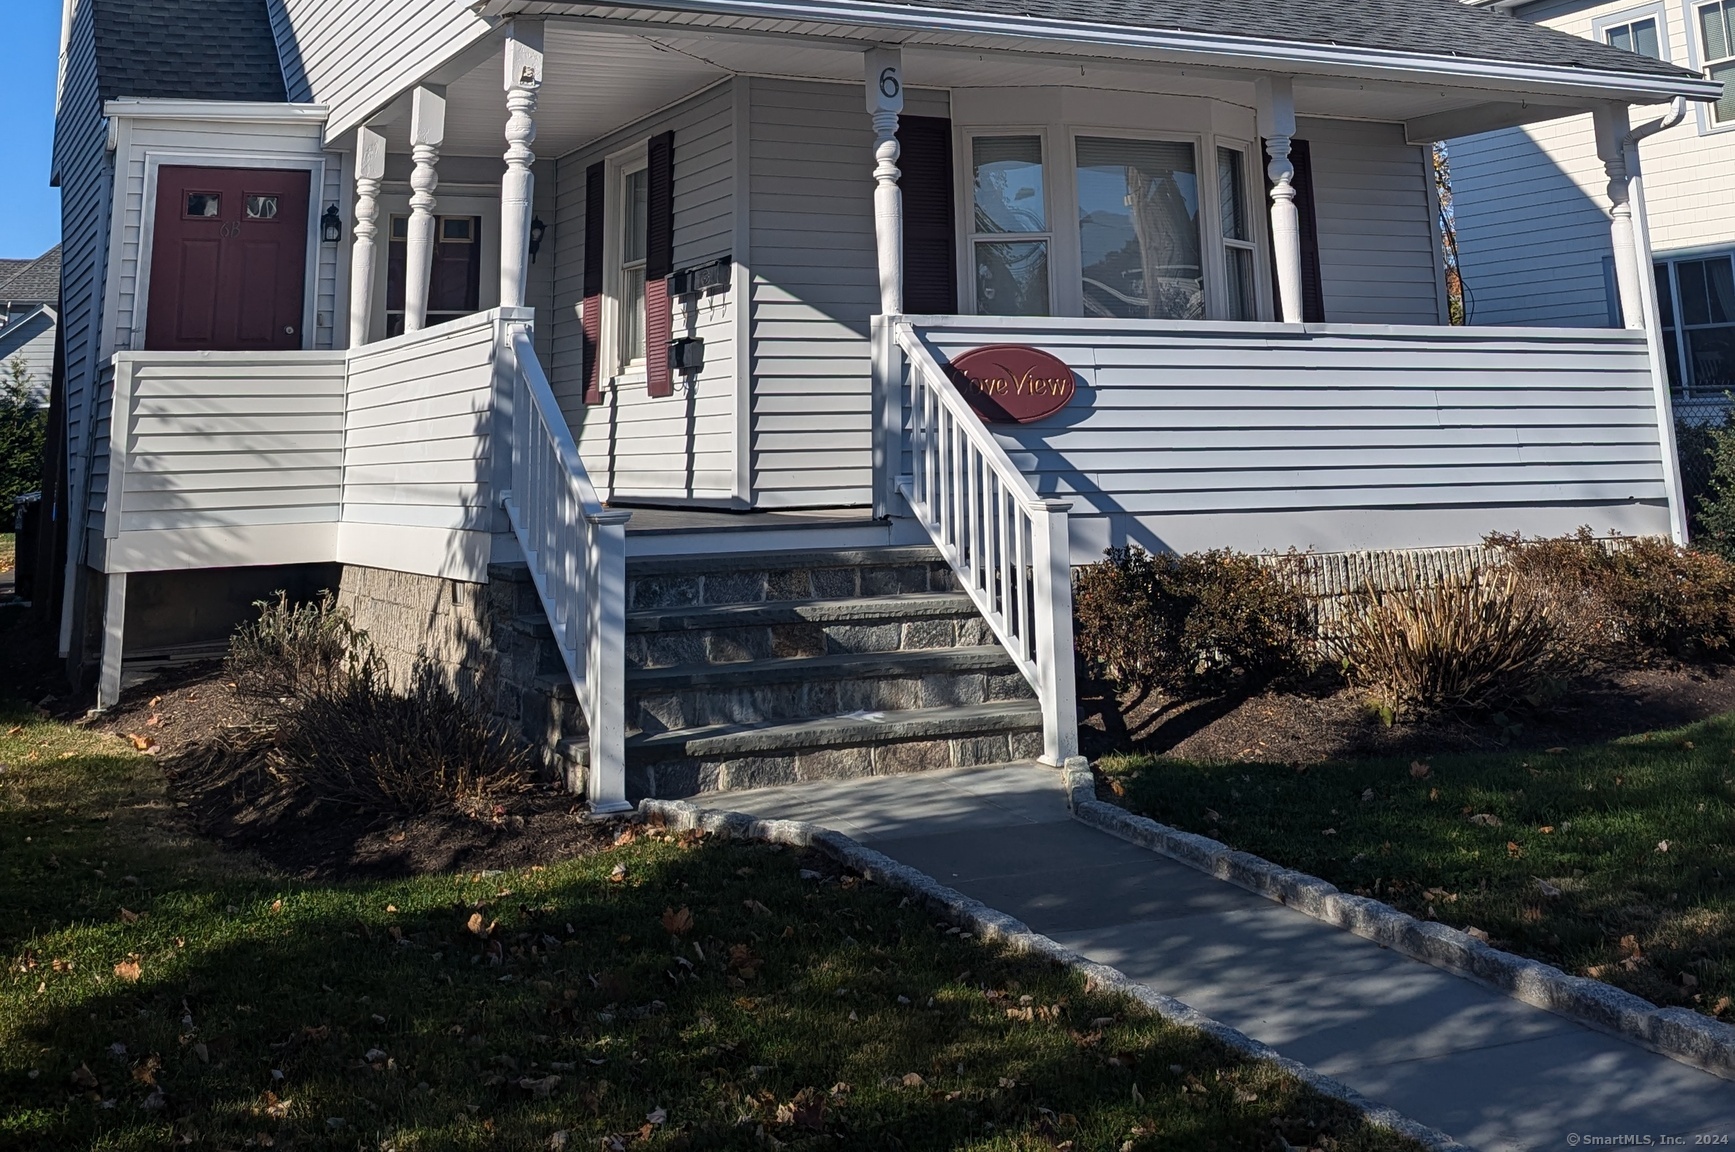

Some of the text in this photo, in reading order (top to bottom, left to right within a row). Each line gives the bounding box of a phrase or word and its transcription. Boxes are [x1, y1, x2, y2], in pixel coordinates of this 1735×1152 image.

[880, 67, 900, 98] 6
[219, 220, 241, 240] 6B
[992, 362, 1067, 396] View
